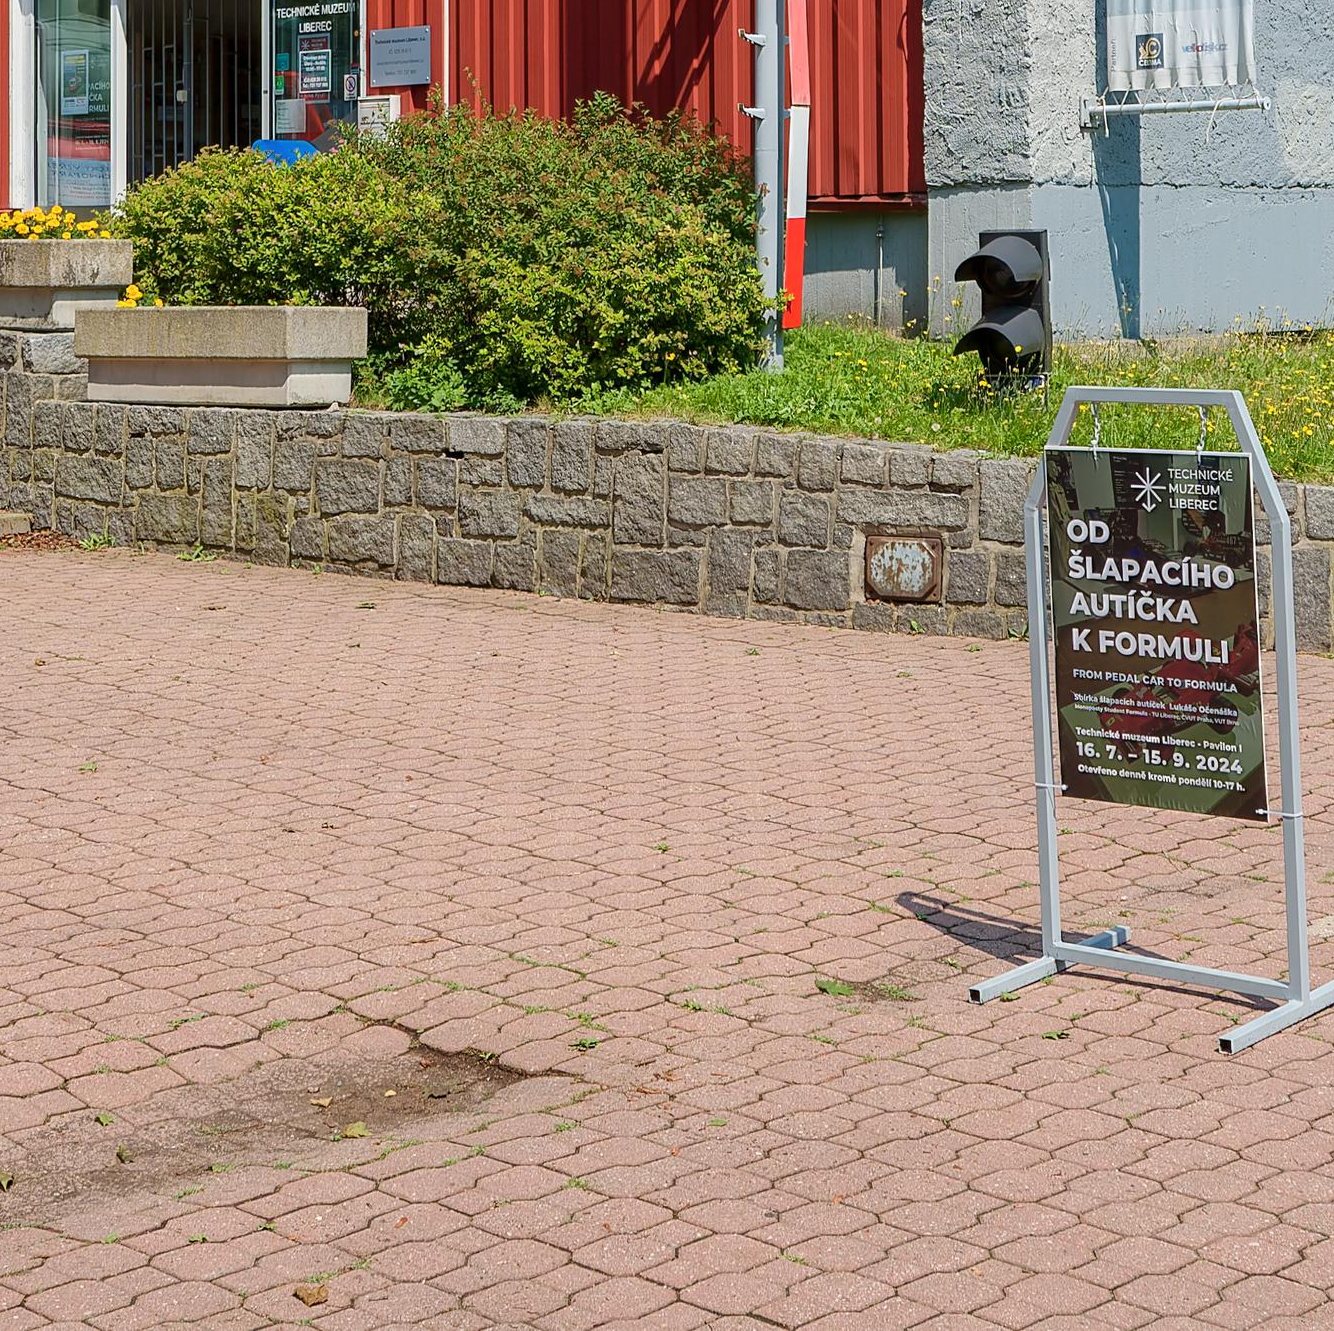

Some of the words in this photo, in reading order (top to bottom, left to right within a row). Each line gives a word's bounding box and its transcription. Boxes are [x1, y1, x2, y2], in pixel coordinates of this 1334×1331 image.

[276, 3, 320, 19] TECHNICKÉ
[321, 2, 356, 15] MUZEUM
[298, 20, 333, 33] LIBEREC
[1167, 468, 1234, 482] TECHNICKÉ
[1168, 483, 1221, 496] MUZEUM
[1169, 498, 1218, 511] LIBEREC
[1067, 519, 1110, 544] OD
[1068, 549, 1235, 590] ŠLAPACÍHO
[1070, 590, 1198, 625] AUTÍČKA
[1071, 627, 1093, 653] K
[1098, 629, 1229, 664] FORMULI
[1072, 668, 1103, 681] FROM
[1105, 672, 1141, 685] PEDAL
[1142, 674, 1165, 687] CAR
[1166, 677, 1182, 688] TO
[1184, 679, 1238, 694] FORMULA
[1073, 693, 1099, 704] Sbírka
[1099, 696, 1136, 707] šlapacích
[1136, 700, 1166, 710] autíček
[1169, 703, 1197, 714] Lukáše
[1198, 704, 1238, 717] Očenáška
[1075, 726, 1121, 740] Technické
[1121, 733, 1161, 745] muzeum
[1161, 735, 1196, 749] Liberec
[1203, 739, 1237, 753] Pavilon
[1075, 741, 1101, 759] 16.
[1105, 744, 1123, 761] 7.
[1142, 748, 1167, 766] 15.
[1172, 752, 1191, 769] 9.
[1195, 754, 1243, 775] 2024
[1077, 763, 1118, 777] Otevřeno
[1118, 767, 1147, 781] denně
[1147, 770, 1177, 784] kromě
[1178, 773, 1212, 788] pondělí
[1213, 779, 1235, 791] 10-17
[1236, 781, 1246, 792] h.
